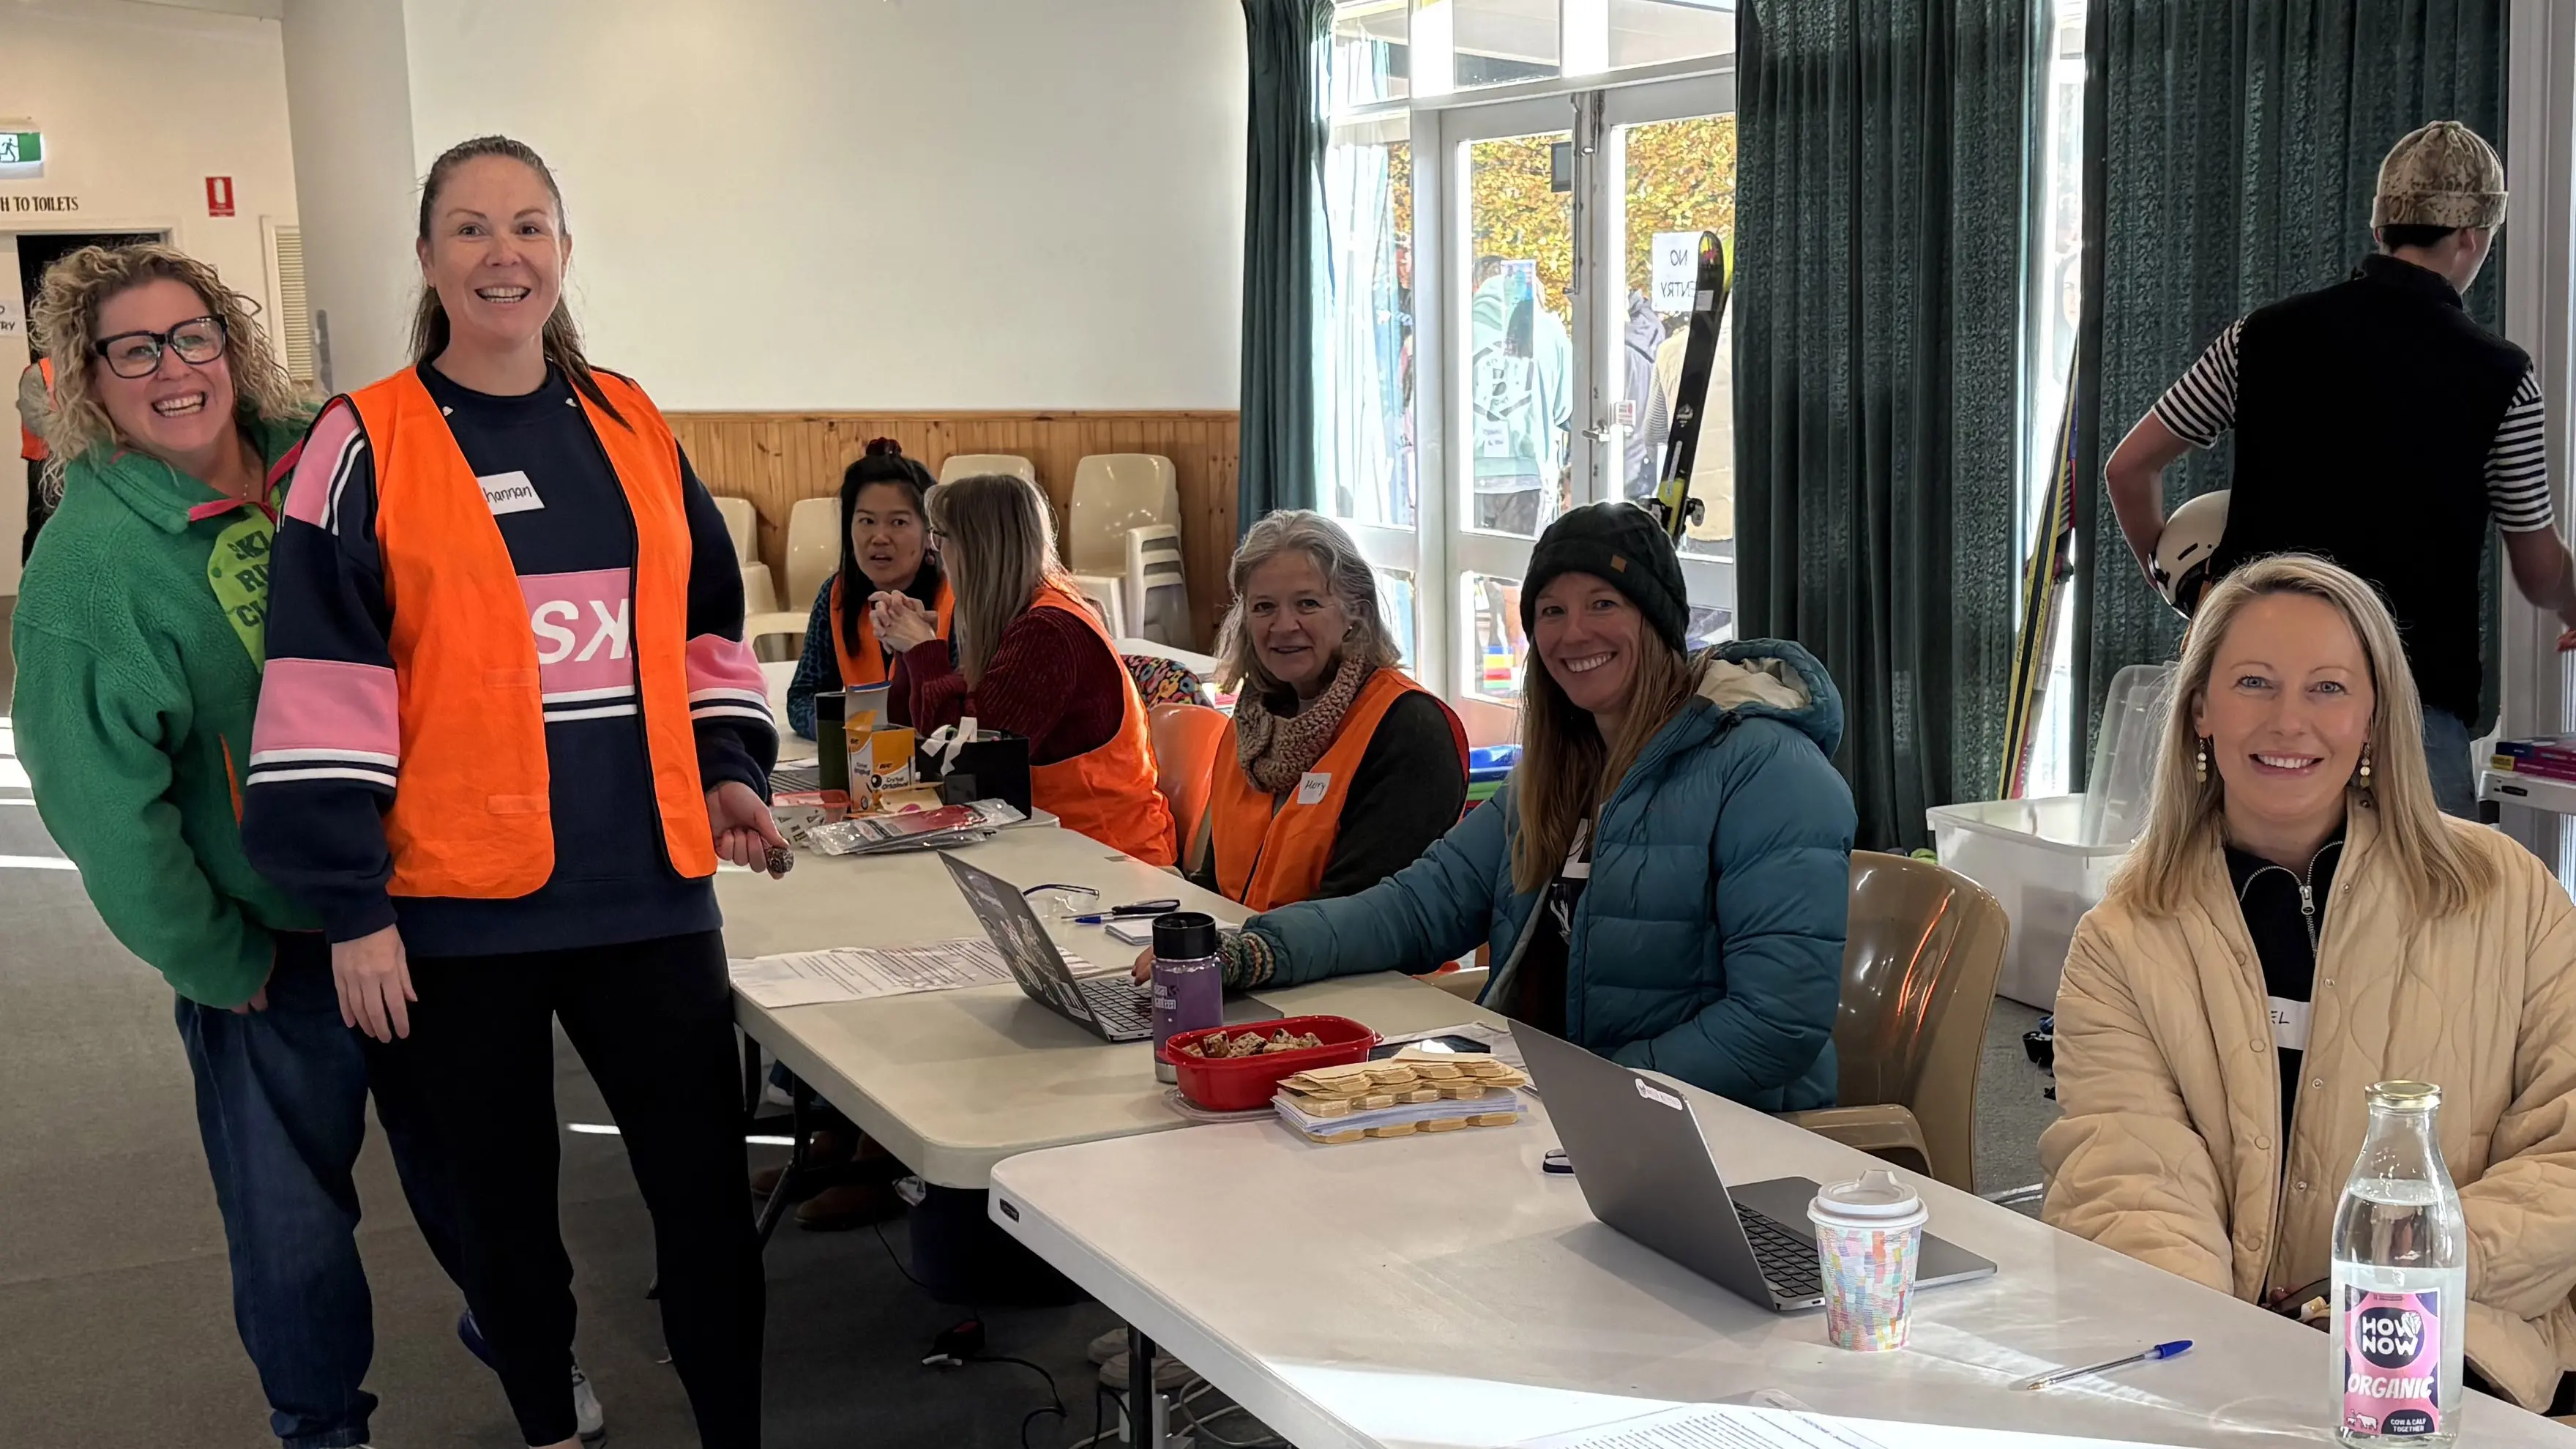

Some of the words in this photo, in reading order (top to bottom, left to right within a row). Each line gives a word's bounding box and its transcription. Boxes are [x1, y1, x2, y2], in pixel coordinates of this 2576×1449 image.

[13, 196, 30, 212] TO
[31, 195, 79, 212] TOILETS
[227, 530, 270, 560] SKI
[2362, 1312, 2422, 1338] HOW
[2362, 1335, 2419, 1356] NOW
[2348, 1372, 2435, 1399] ORGANIC
